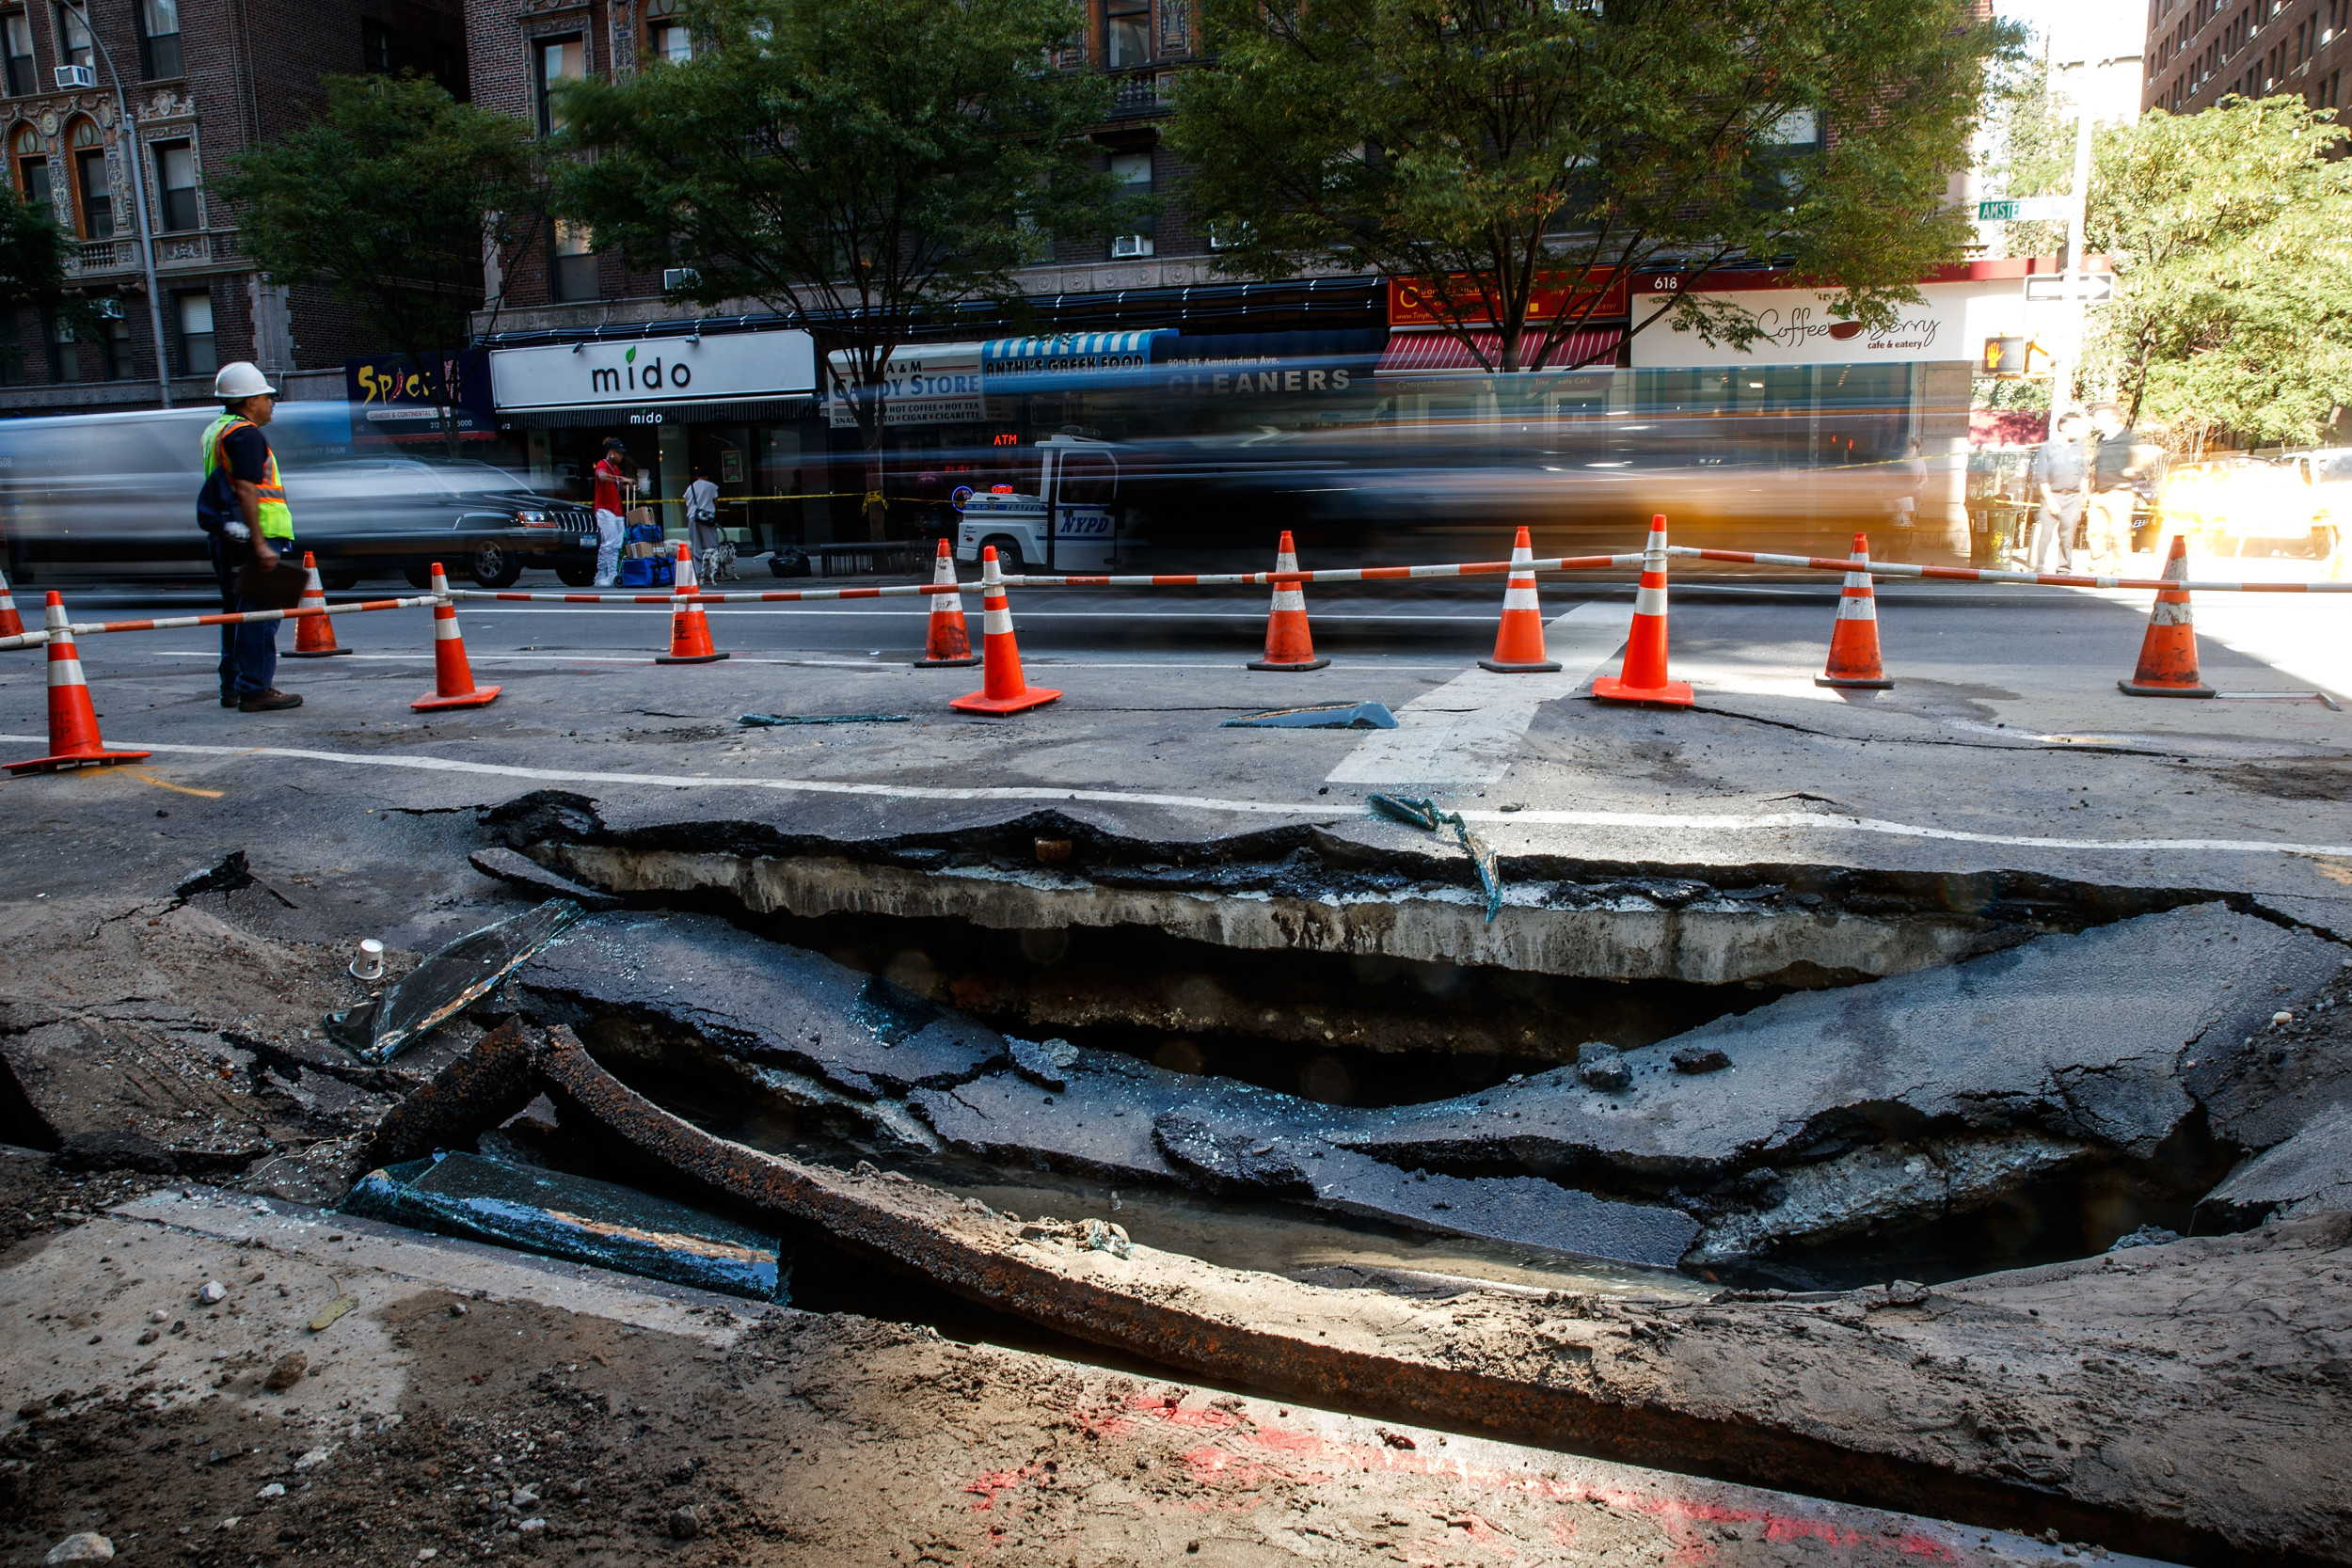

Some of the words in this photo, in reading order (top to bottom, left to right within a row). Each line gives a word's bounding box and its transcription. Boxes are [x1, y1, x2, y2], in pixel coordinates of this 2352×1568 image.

[1981, 202, 2028, 219] AMSTE
[1654, 277, 1677, 290] 618
[1756, 307, 1831, 347] Coffee
[1867, 340, 1884, 349] cafe
[1886, 340, 1893, 348] &
[1895, 340, 1923, 349] eatery
[886, 362, 895, 373] A
[899, 364, 907, 372] &
[910, 360, 923, 372] M
[985, 358, 1044, 380] ANTHI'S
[1046, 356, 1098, 377] GREEK
[1100, 353, 1146, 374] FOOD
[1168, 357, 1186, 368] 90th
[1203, 356, 1257, 367] Amsterdam
[1259, 355, 1280, 365] Ave.
[591, 345, 691, 392] mido
[833, 378, 903, 399] CADY
[911, 374, 979, 395] STORE
[1168, 369, 1350, 396] CLEANERS
[1534, 378, 1549, 387] Tiny
[908, 404, 938, 412] COFFEE
[945, 403, 961, 411] HOT
[964, 402, 979, 410] TEA
[371, 411, 390, 420] CHINESE
[397, 410, 432, 419] CONTINENTAL
[629, 408, 663, 425] mido
[835, 416, 858, 425] SNAC
[935, 411, 980, 420] CIGARETTE
[993, 434, 1018, 446] ATM
[991, 484, 1013, 495] OPEN
[1060, 516, 1110, 533] NYPD
